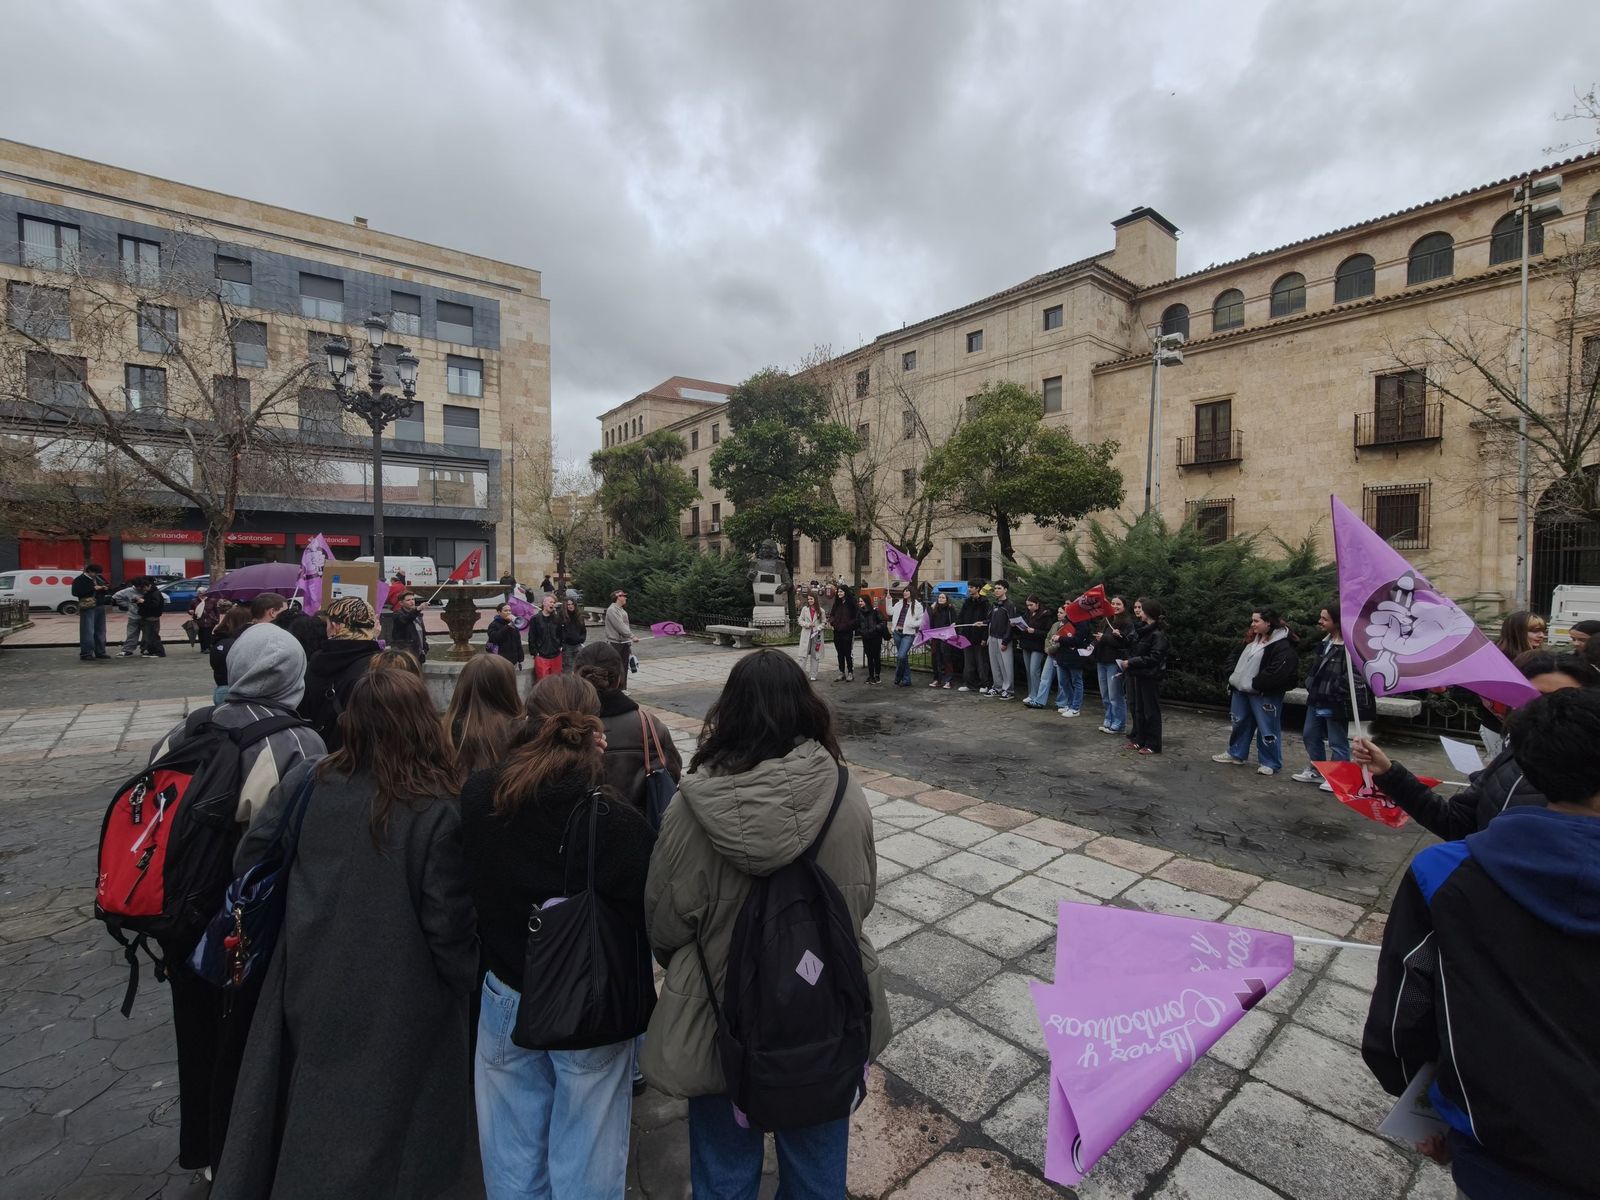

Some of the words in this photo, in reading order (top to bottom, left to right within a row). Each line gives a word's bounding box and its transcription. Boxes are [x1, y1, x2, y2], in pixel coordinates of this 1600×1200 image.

[1045, 988, 1227, 1049] Combativas
[1109, 1018, 1197, 1066] Libres
[1077, 1042, 1098, 1067] y
